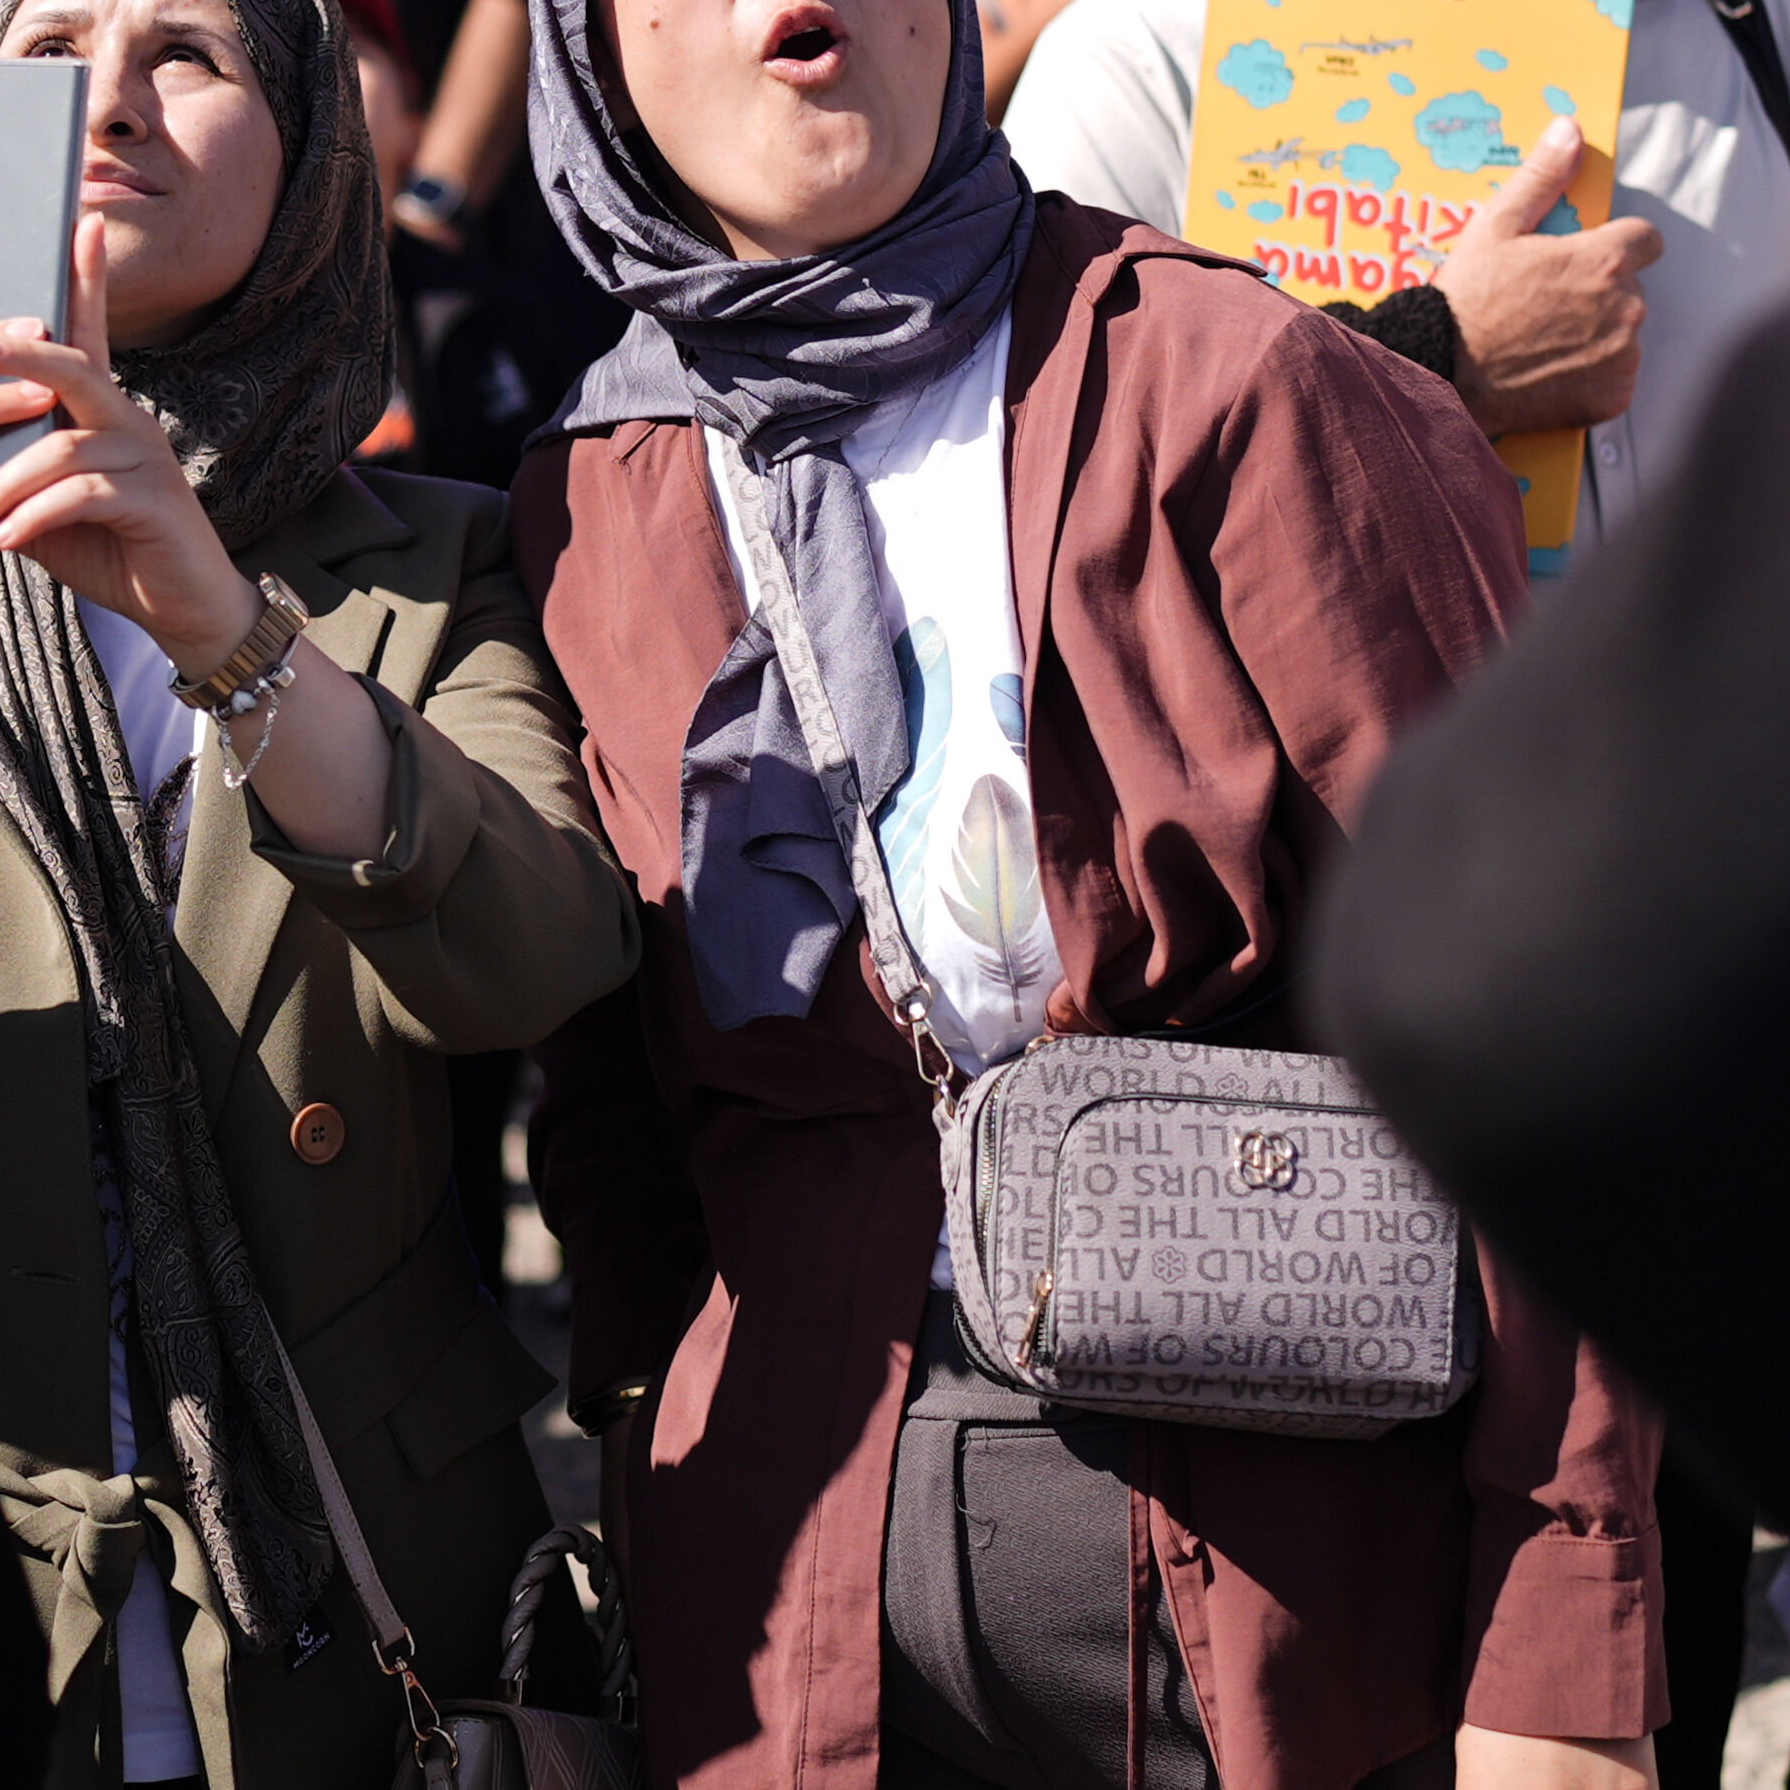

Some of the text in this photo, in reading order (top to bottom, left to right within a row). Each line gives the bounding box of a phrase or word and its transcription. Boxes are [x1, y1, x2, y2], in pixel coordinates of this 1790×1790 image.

[1085, 1122, 1174, 1155] THE
[1284, 1126, 1404, 1160] ORLD
[1133, 1163, 1346, 1202] COOURS
[1117, 1206, 1209, 1240] THE
[1216, 1208, 1299, 1243] ALL
[1059, 1247, 1436, 1287] OF WORLD ALL
[1060, 1289, 1152, 1325] THE
[1162, 1290, 1246, 1326] ALL
[1261, 1291, 1427, 1330] WORLD
[1125, 1332, 1187, 1366] OF
[1202, 1332, 1416, 1372] COLOURS
